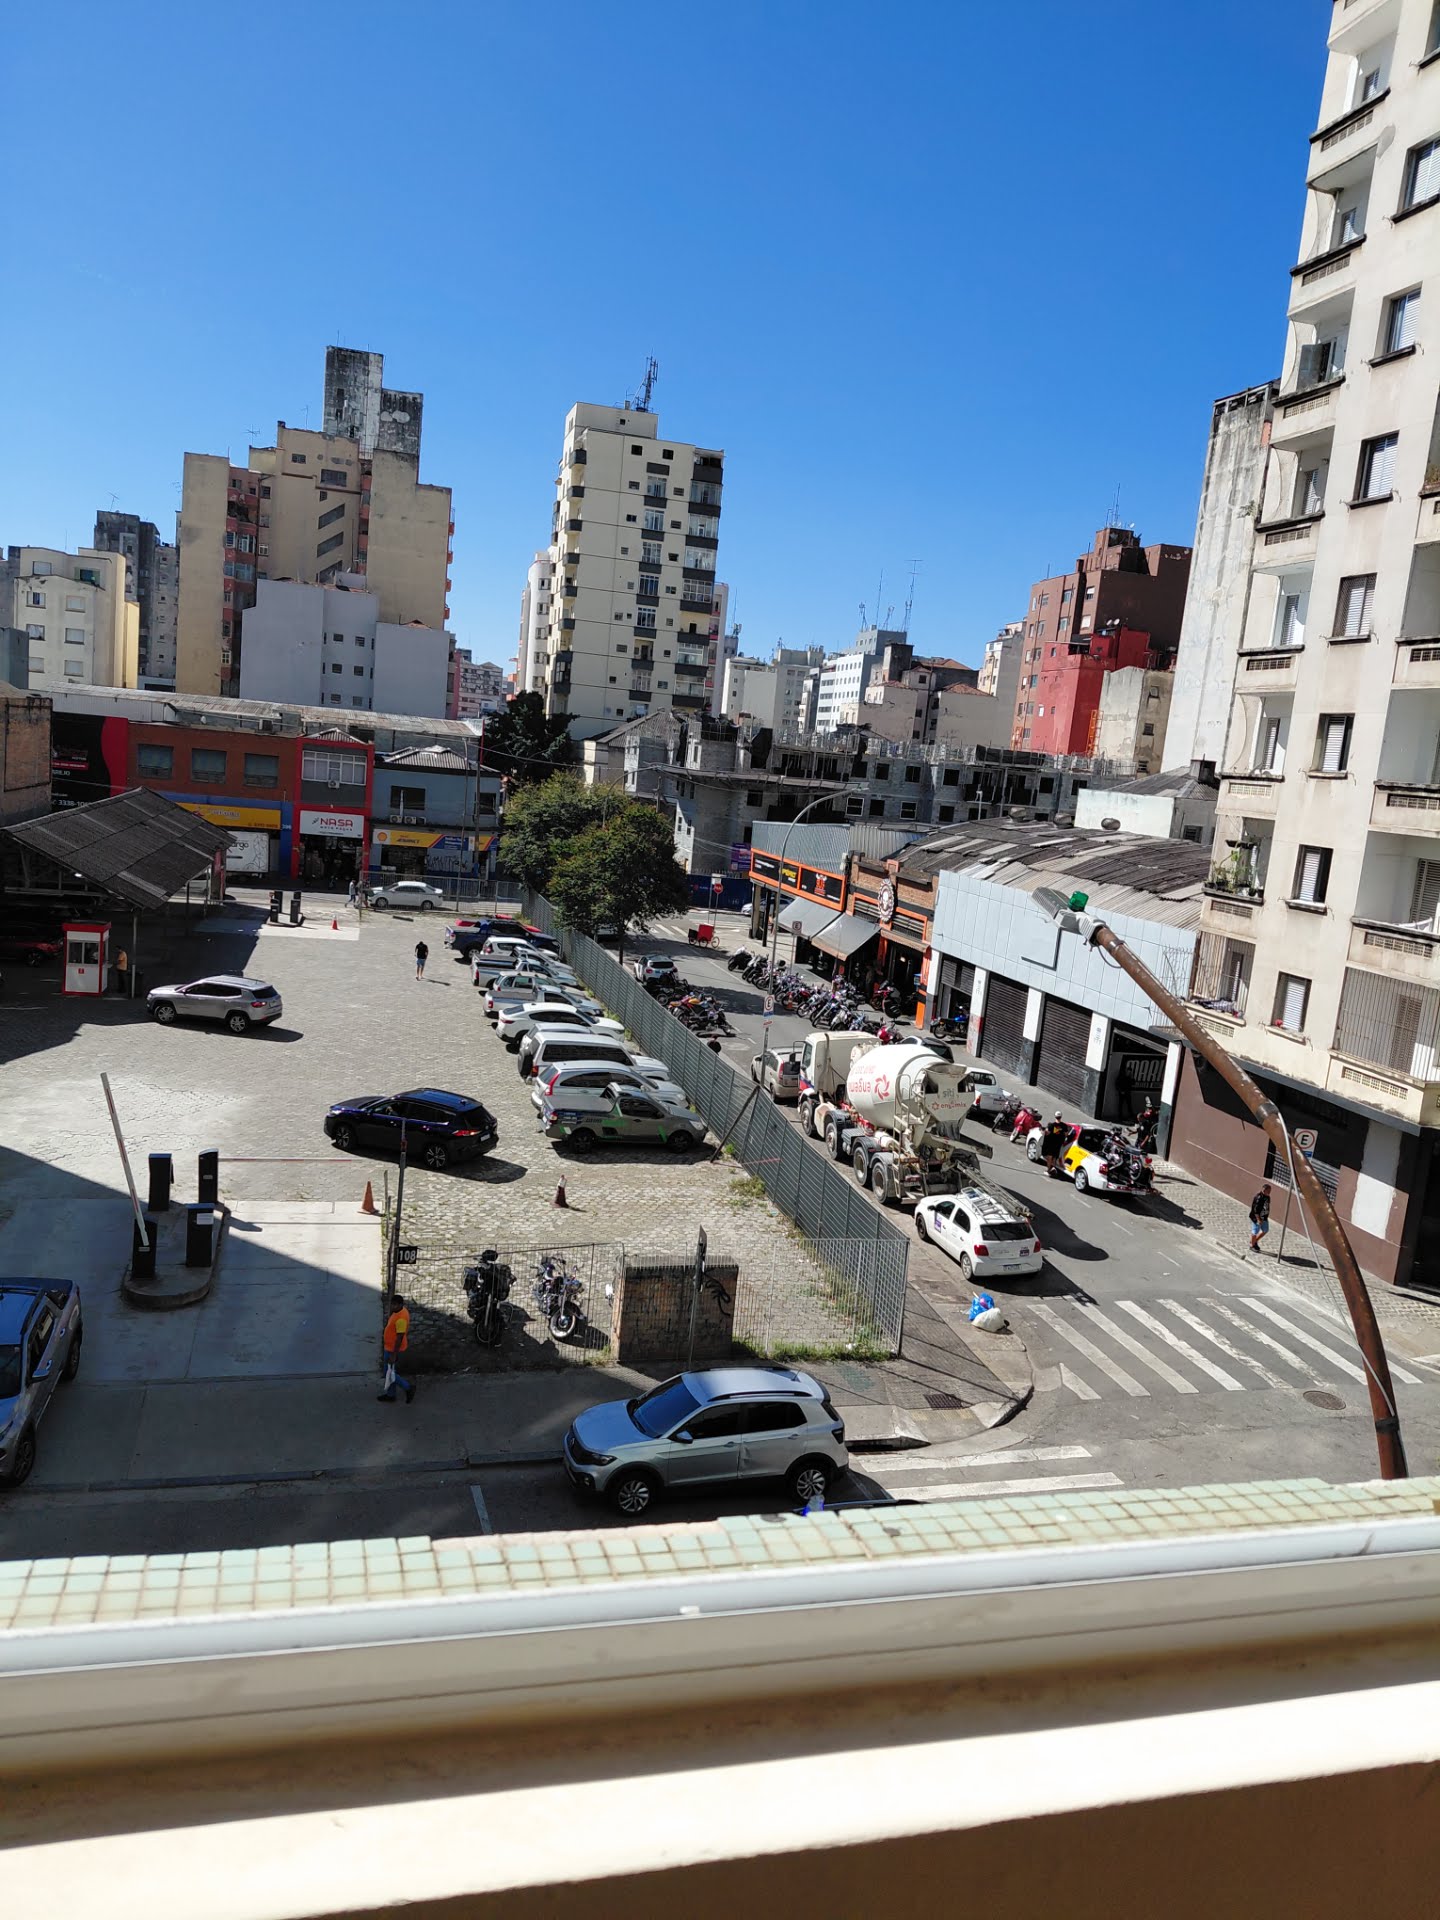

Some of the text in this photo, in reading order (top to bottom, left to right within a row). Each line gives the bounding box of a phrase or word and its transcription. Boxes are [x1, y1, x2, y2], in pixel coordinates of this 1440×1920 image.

[320, 817, 353, 828] NASA
[1300, 1134, 1309, 1146] E
[399, 1250, 416, 1261] 108
